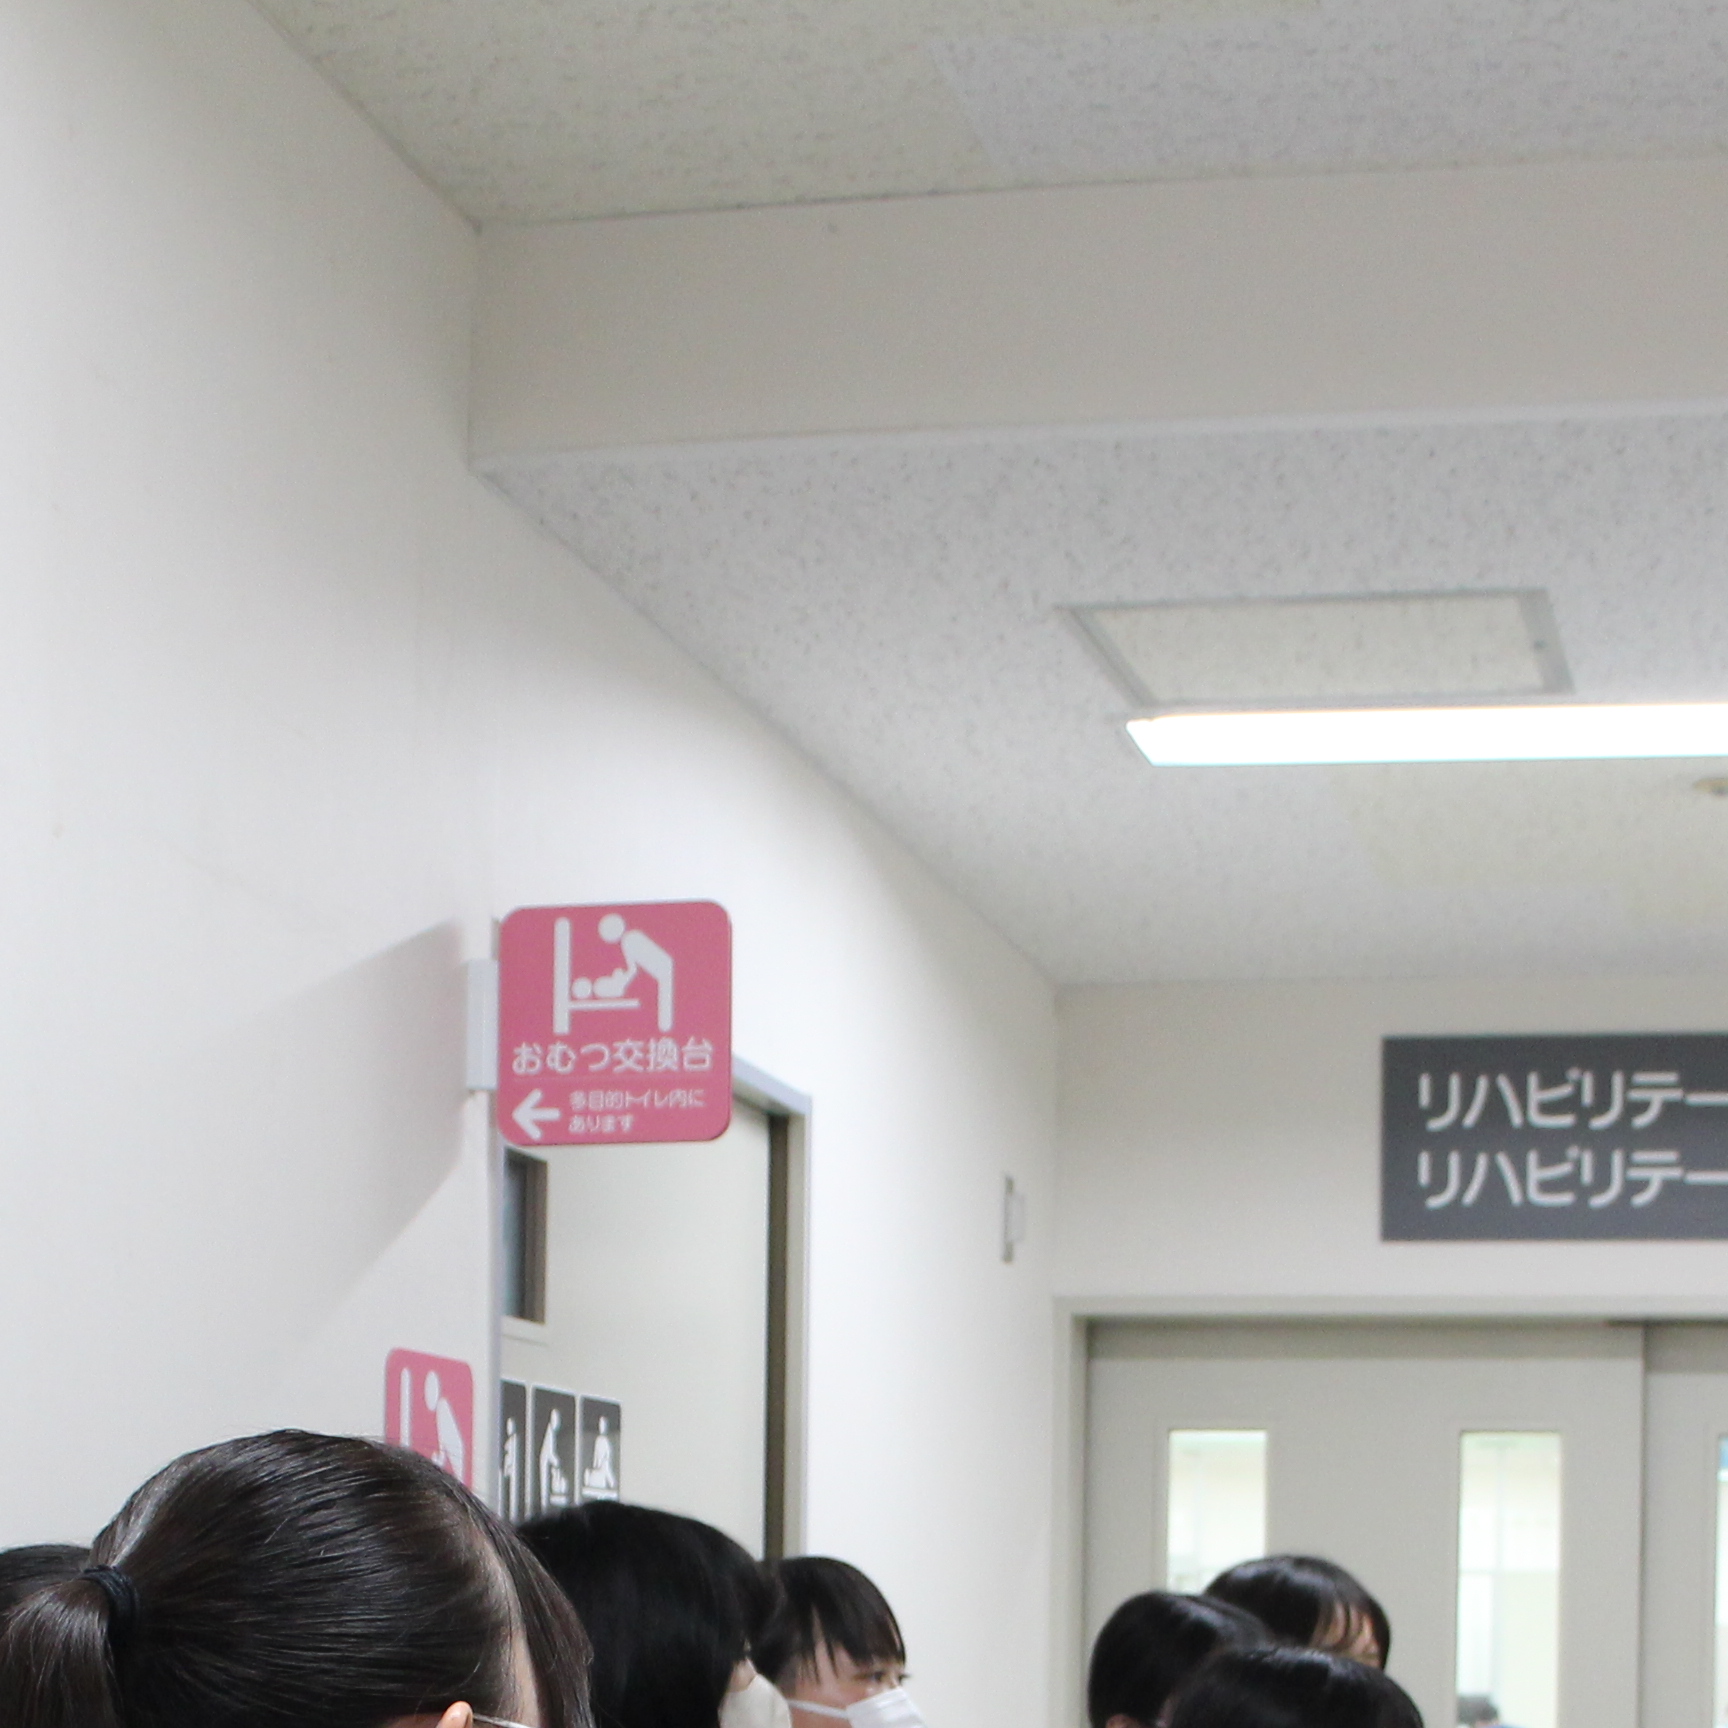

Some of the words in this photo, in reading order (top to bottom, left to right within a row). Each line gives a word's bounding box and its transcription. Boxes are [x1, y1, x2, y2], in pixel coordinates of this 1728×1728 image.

[512, 1037, 713, 1075] おむつ交換台
[570, 1088, 706, 1111] 多目的トイレ内に
[569, 1114, 634, 1133] あります
